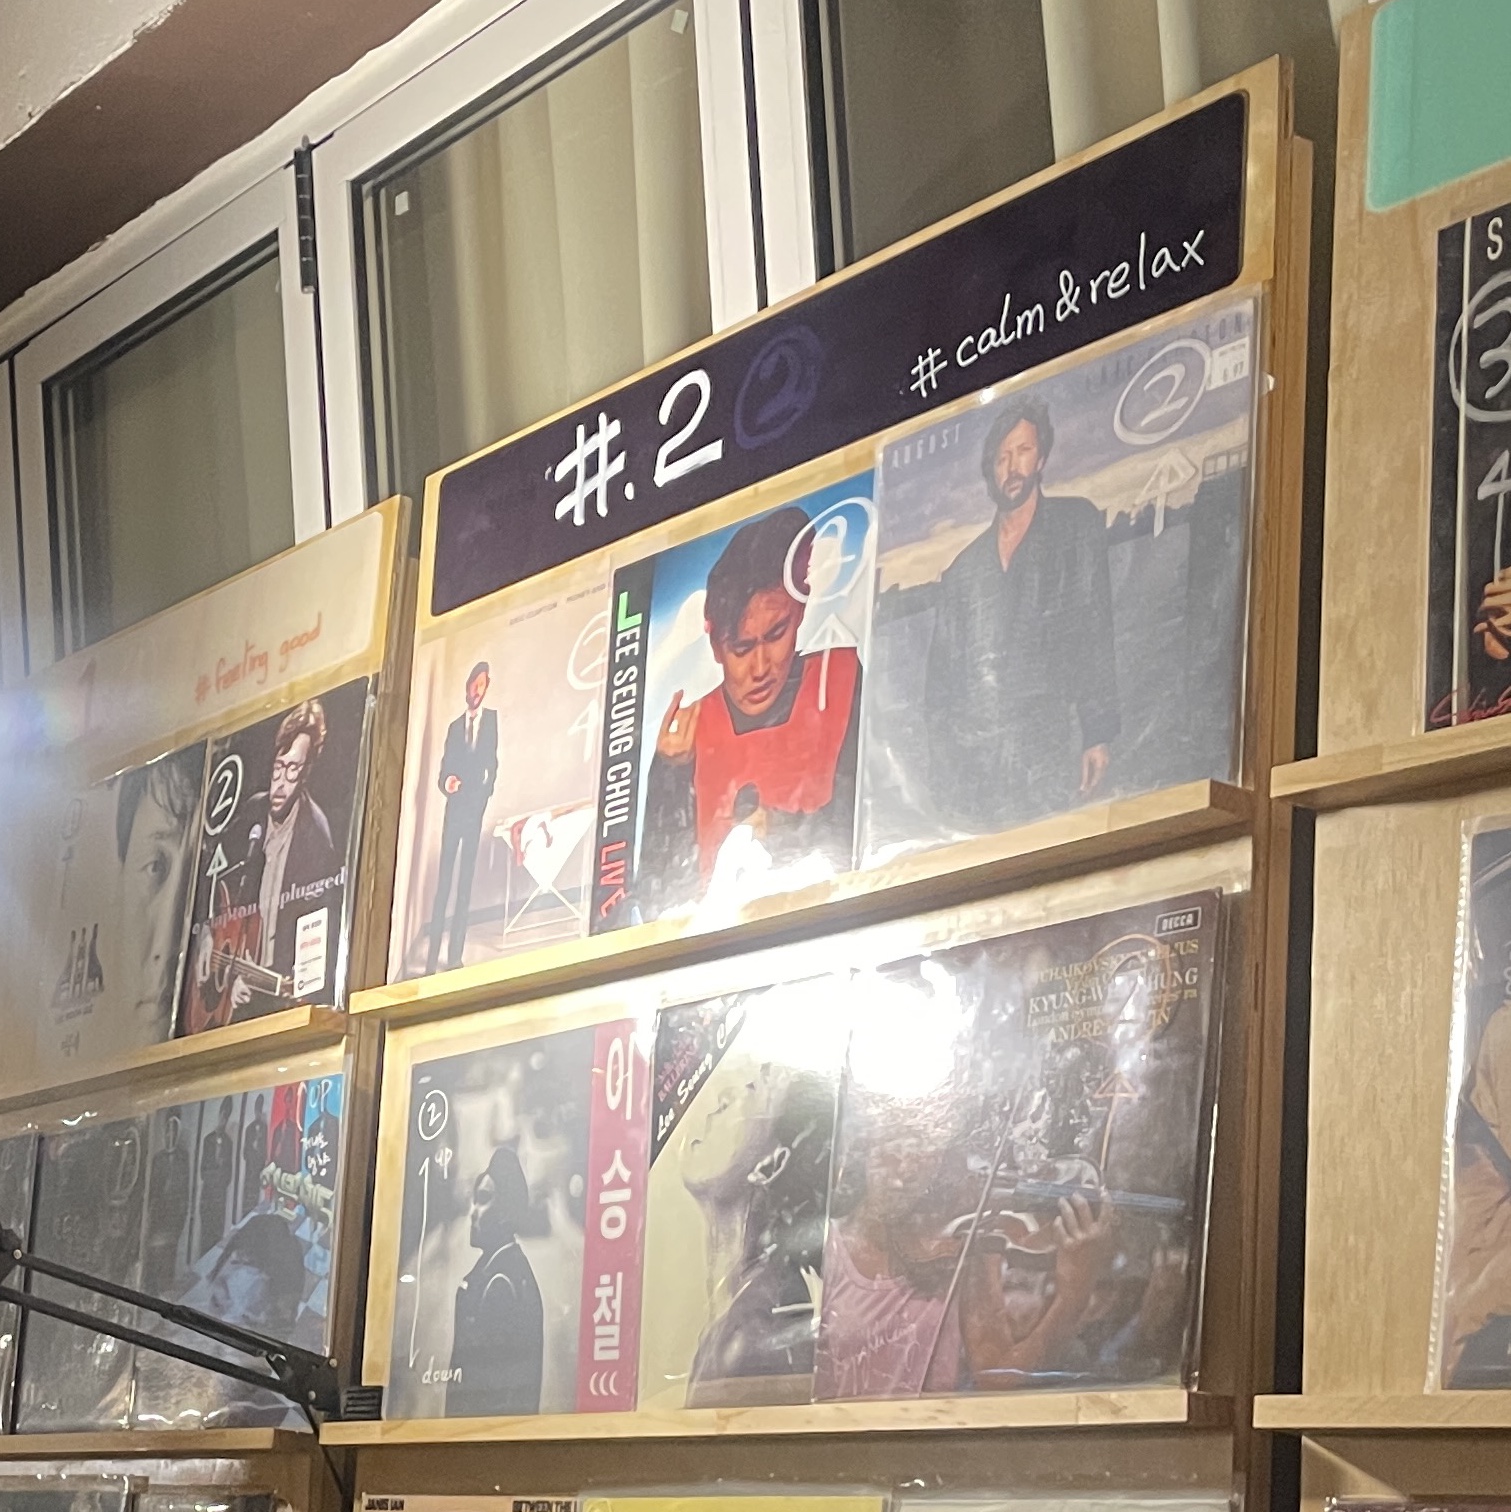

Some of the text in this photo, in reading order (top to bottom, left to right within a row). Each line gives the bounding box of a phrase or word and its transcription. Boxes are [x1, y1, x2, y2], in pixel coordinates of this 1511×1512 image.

[614, 590, 644, 662] LEE
[606, 667, 639, 755] SEUNG
[601, 760, 634, 838] CHUL
[268, 865, 348, 912] plugged
[1161, 913, 1194, 931] DECCA
[1145, 967, 1199, 992] HUNG
[591, 1031, 636, 1362] 이승철
[421, 1355, 464, 1385] down
